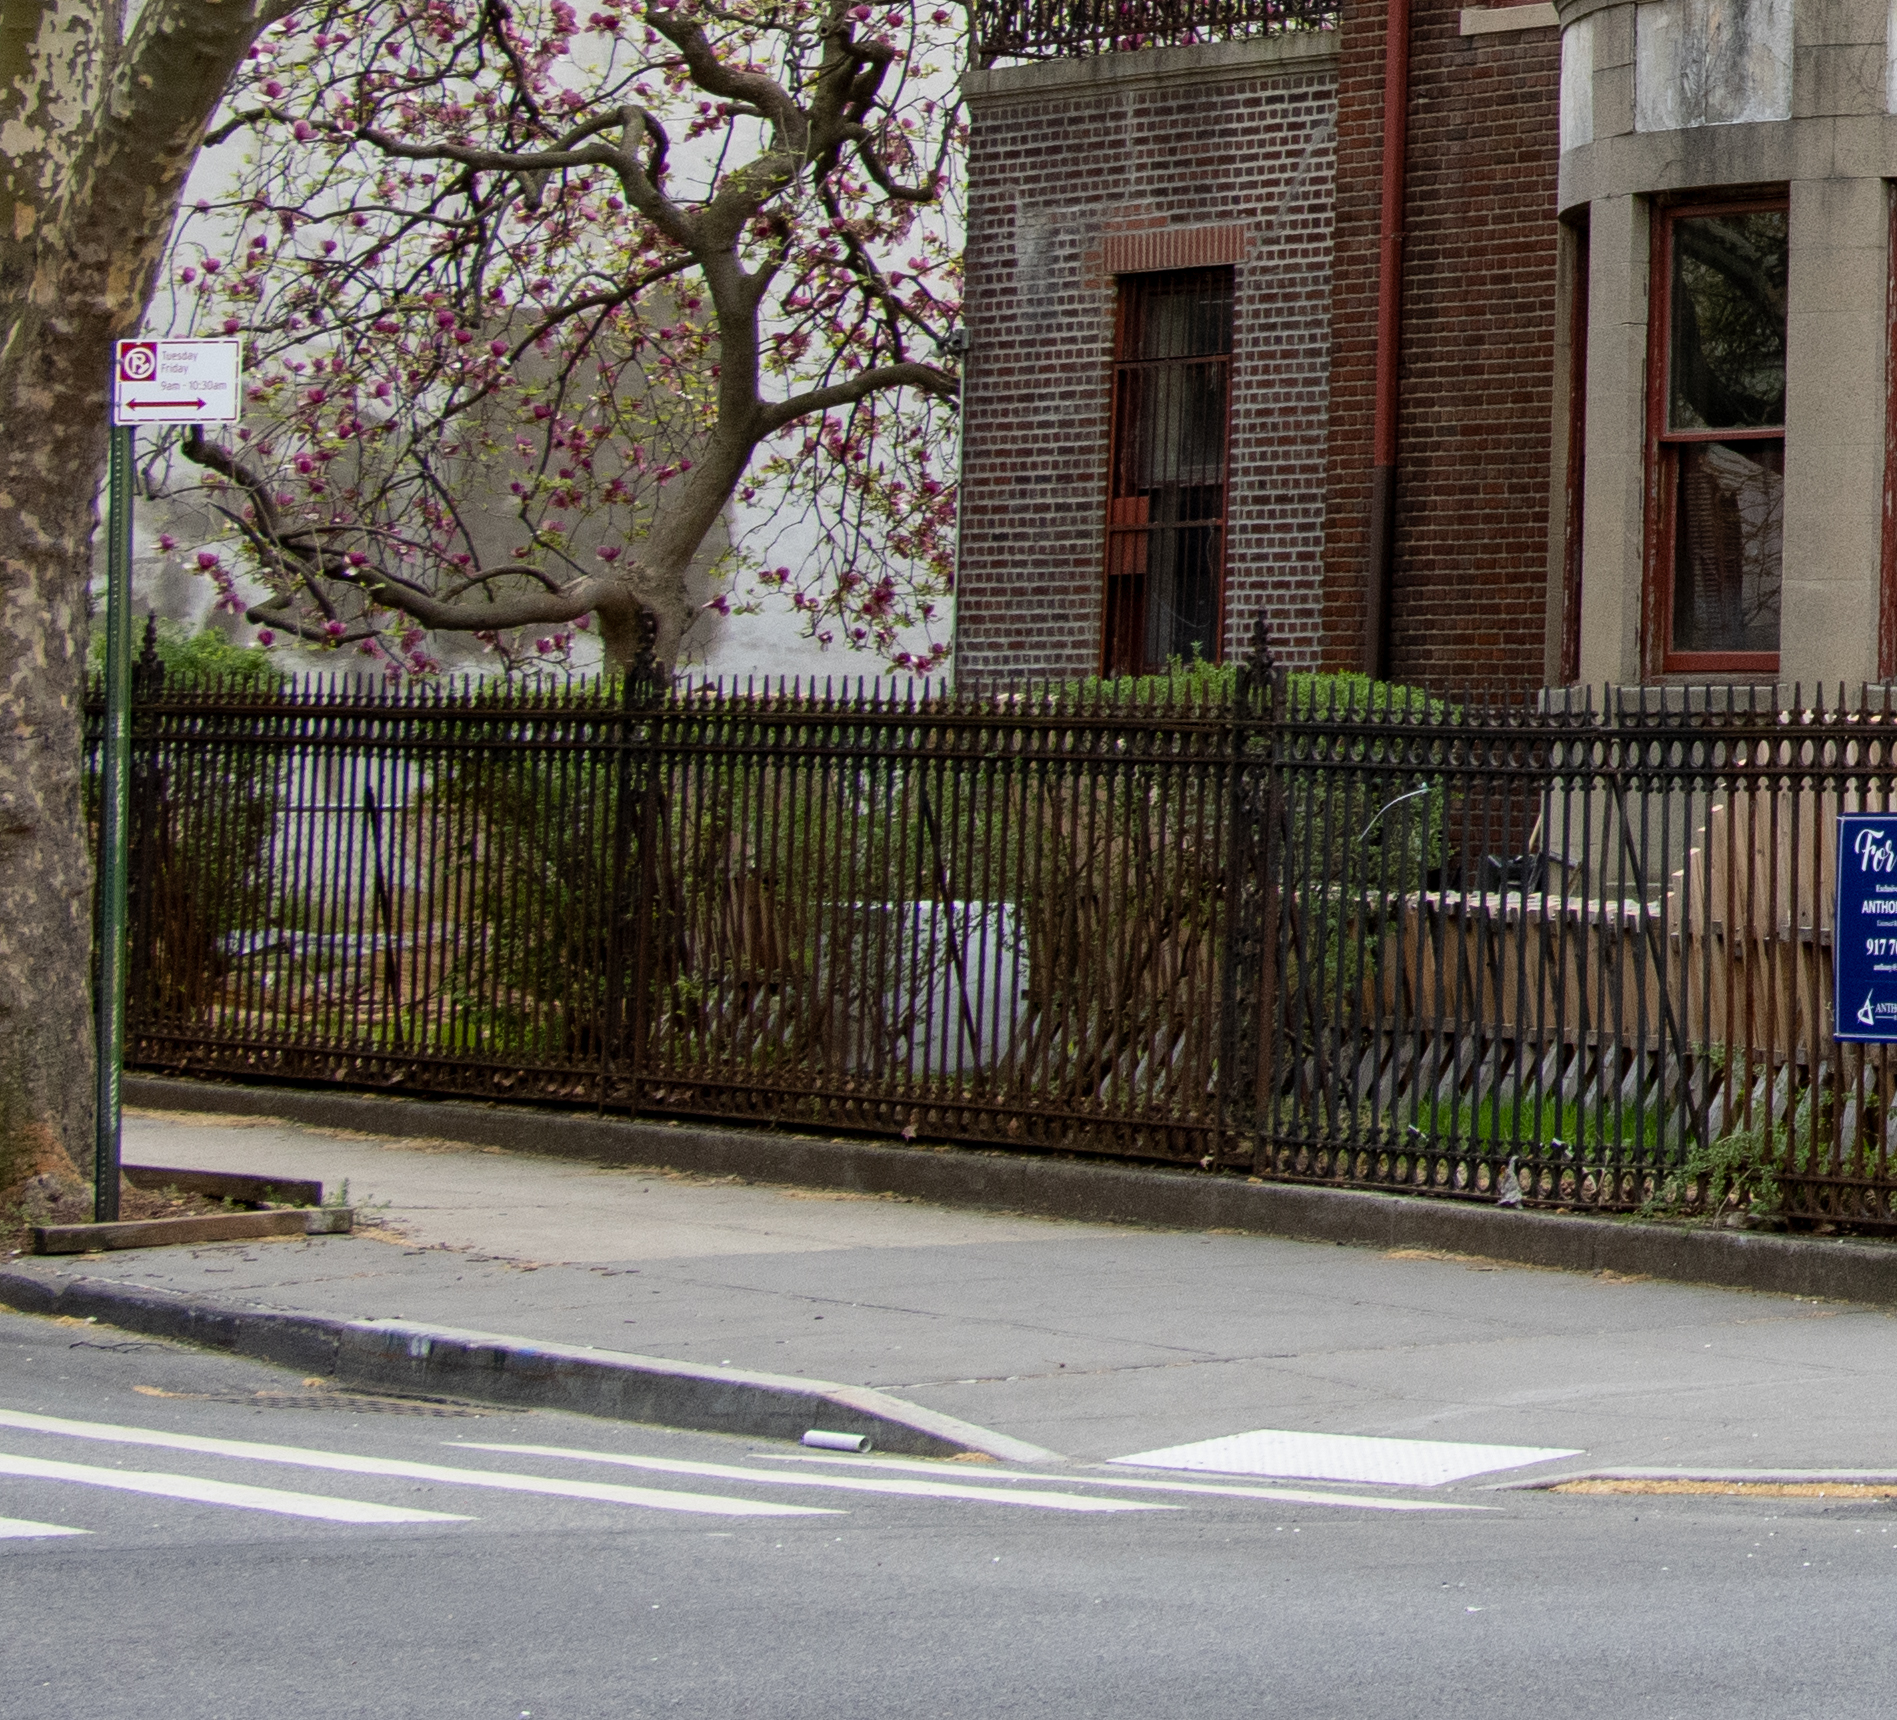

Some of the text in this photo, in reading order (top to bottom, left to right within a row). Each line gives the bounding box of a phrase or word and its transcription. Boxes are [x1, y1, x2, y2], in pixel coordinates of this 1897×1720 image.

[162, 351, 198, 362] Tuesday
[161, 364, 189, 375] Friday
[189, 381, 227, 391] 10:30am
[1855, 829, 1897, 872] For
[1866, 938, 1886, 955] 917
